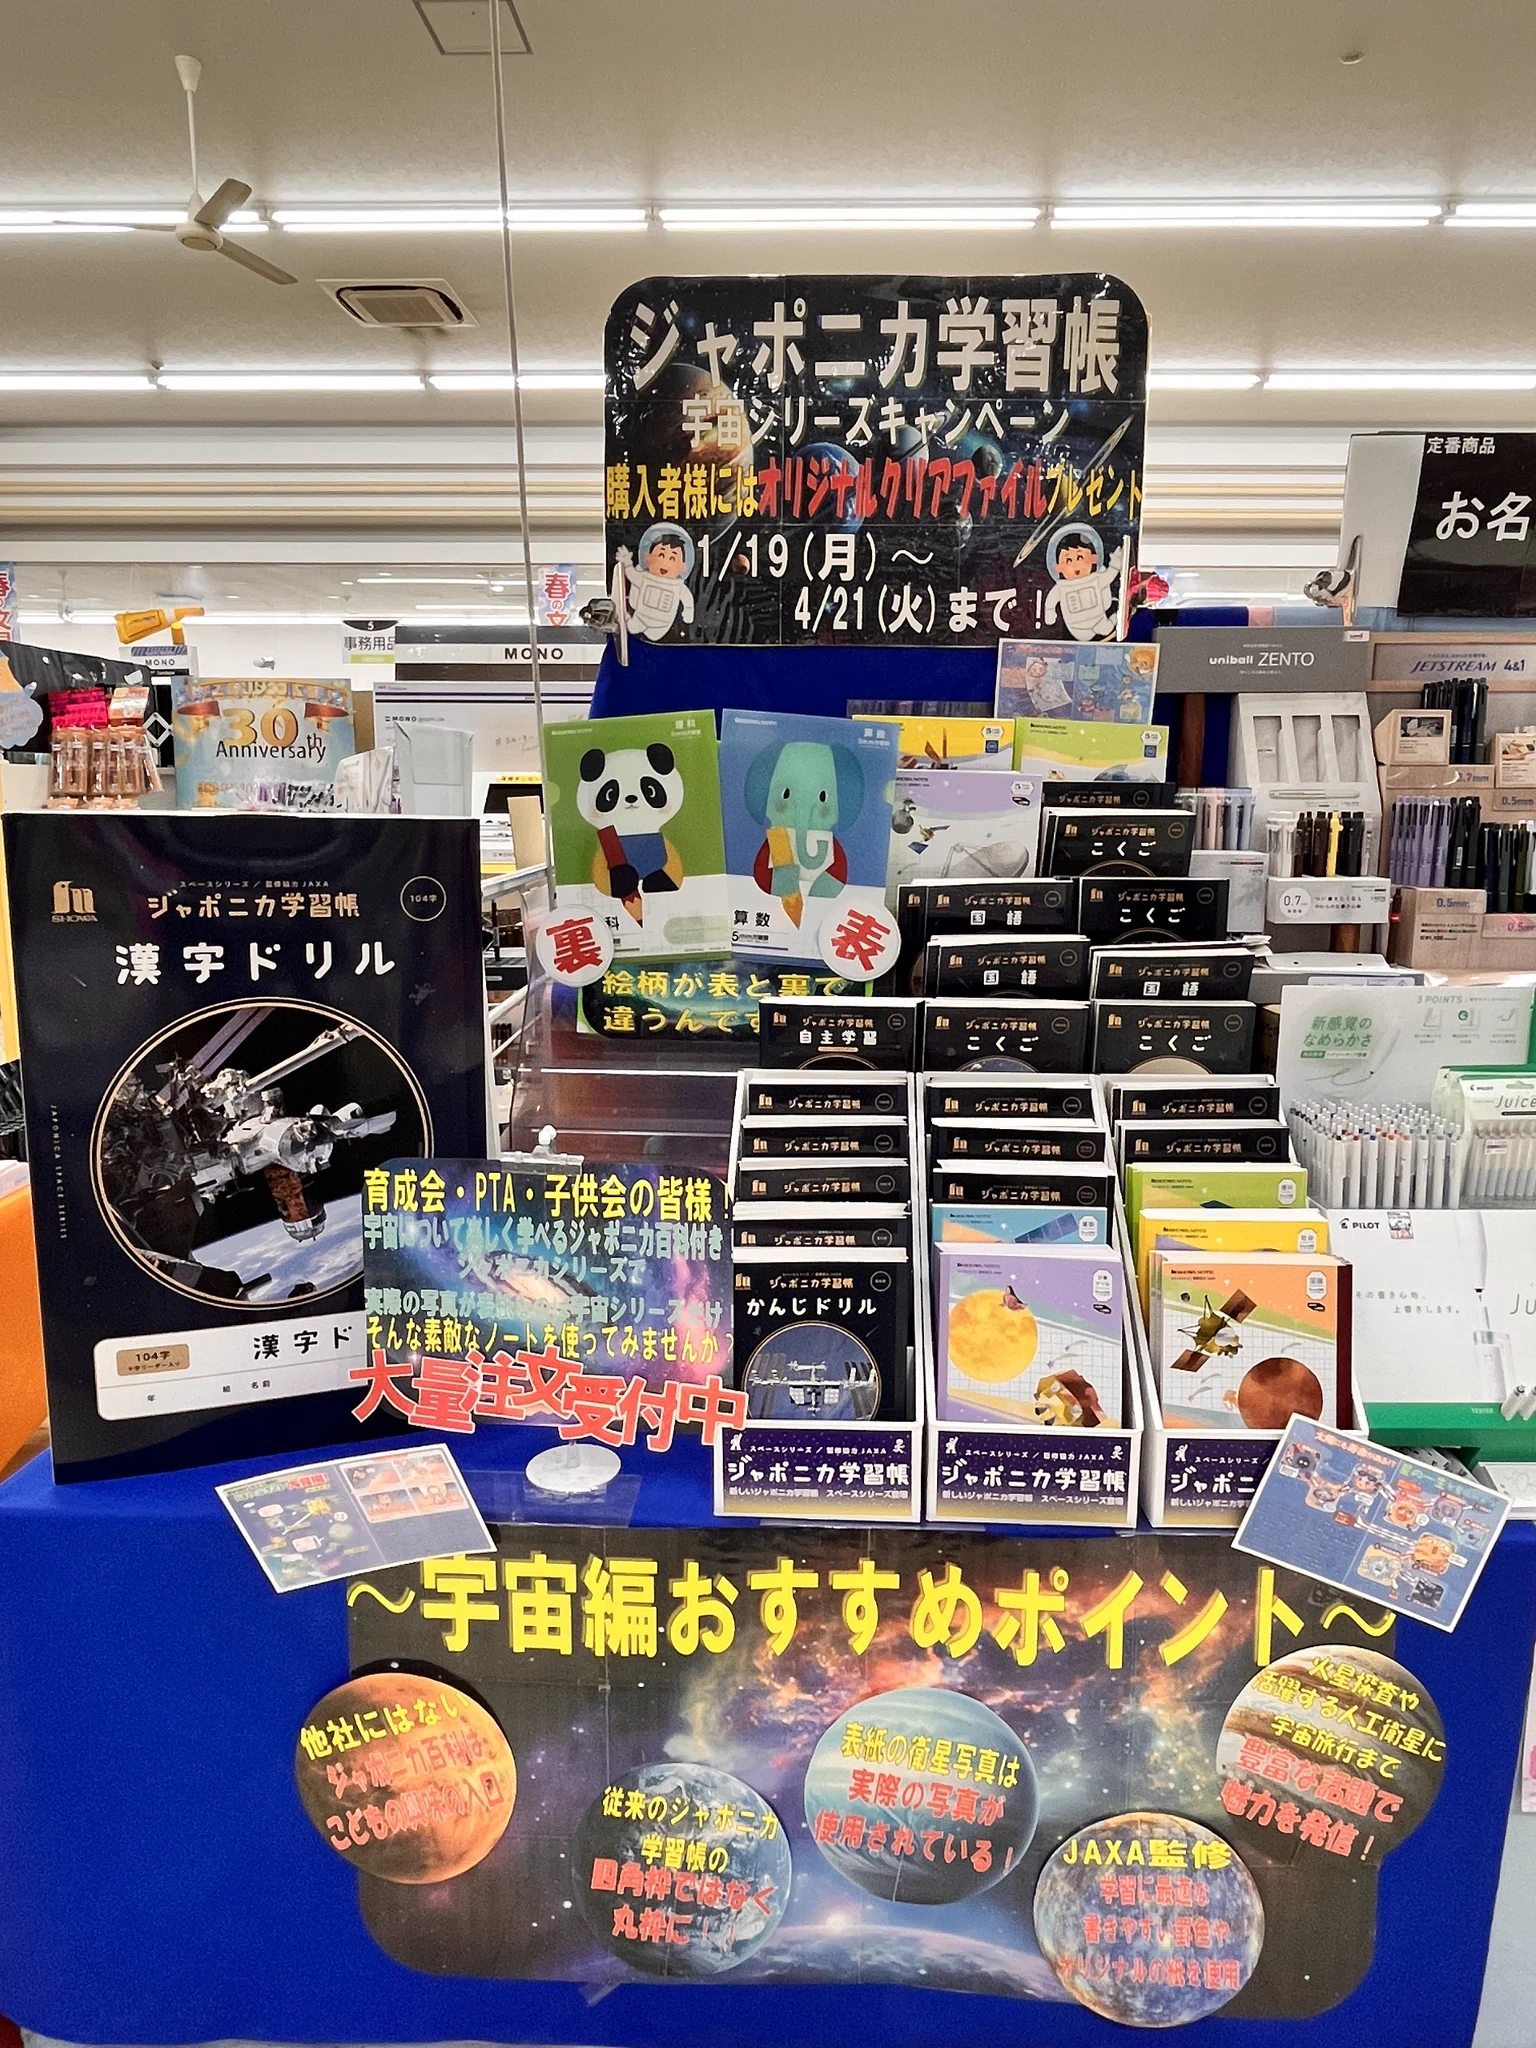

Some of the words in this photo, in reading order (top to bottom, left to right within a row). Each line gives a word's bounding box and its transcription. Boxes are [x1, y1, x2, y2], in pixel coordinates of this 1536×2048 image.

[629, 295, 1121, 393] ジャポニカ学習帳
[681, 396, 1069, 448] 宇宙シリーズキャンペーン
[1426, 437, 1496, 455] 定番商品
[605, 458, 1143, 521] 購入者様にはオリジナルクリアファイルプレゼント
[1435, 491, 1533, 542] お名
[504, 648, 564, 660] MONO
[1209, 655, 1254, 665] uniball
[1257, 652, 1315, 667] ZENTO
[1410, 661, 1497, 673] JETSTREAM
[1504, 659, 1525, 671] 4&1
[216, 740, 327, 764] Anniversary
[1091, 841, 1157, 856] こくご
[51, 915, 98, 923] SHOWA
[148, 888, 360, 918] ジャポニカ学習帳
[734, 910, 770, 928] 算数
[970, 910, 1023, 926] 国語
[1120, 907, 1186, 923] こくご
[545, 915, 604, 975] 裏
[831, 908, 892, 972] 表
[115, 940, 396, 986] 漢字ドリル
[983, 969, 1037, 985] 国語
[1143, 981, 1199, 997] 国語
[799, 1029, 878, 1046] 自主学習
[966, 1035, 1040, 1052] こくご
[1138, 1034, 1212, 1052] こくご
[364, 1167, 731, 1223] 育成会・PTA・子供会の皆様！
[769, 1277, 854, 1290] ジャポニカ学習帳
[746, 1297, 877, 1317] かんじドリル
[135, 1350, 171, 1362] 104字
[253, 1326, 353, 1360] 漢字ド
[350, 1347, 749, 1452] 大量注文受付中
[728, 1454, 909, 1486] ジャポニカ学習帳
[941, 1458, 1126, 1493] ジャポニカ学習帳
[1308, 1656, 1420, 1713] 火星探査や
[300, 1692, 471, 1761] 他社にはない
[1252, 1670, 1447, 1762] 活躍する人工衛星に
[840, 1721, 1021, 1788] 表紙の衛星写真は
[1271, 1715, 1402, 1779] 宇宙旅行まで
[1235, 1733, 1405, 1823] 豊富な話題で
[602, 1785, 779, 1840] 従来のジャポニカ
[848, 1768, 1006, 1827] 実際の写真が
[1220, 1778, 1375, 1862] 魅力を発信！
[641, 1834, 730, 1874] 学習帳の
[814, 1808, 1014, 1877] 使用されている！
[1063, 1838, 1232, 1870] JAXA監修
[590, 1857, 776, 1916] 四角枠ではなく
[1100, 1874, 1209, 1908] 学習に最適な
[1058, 1953, 1241, 1992] オリジナルの紙を使用
